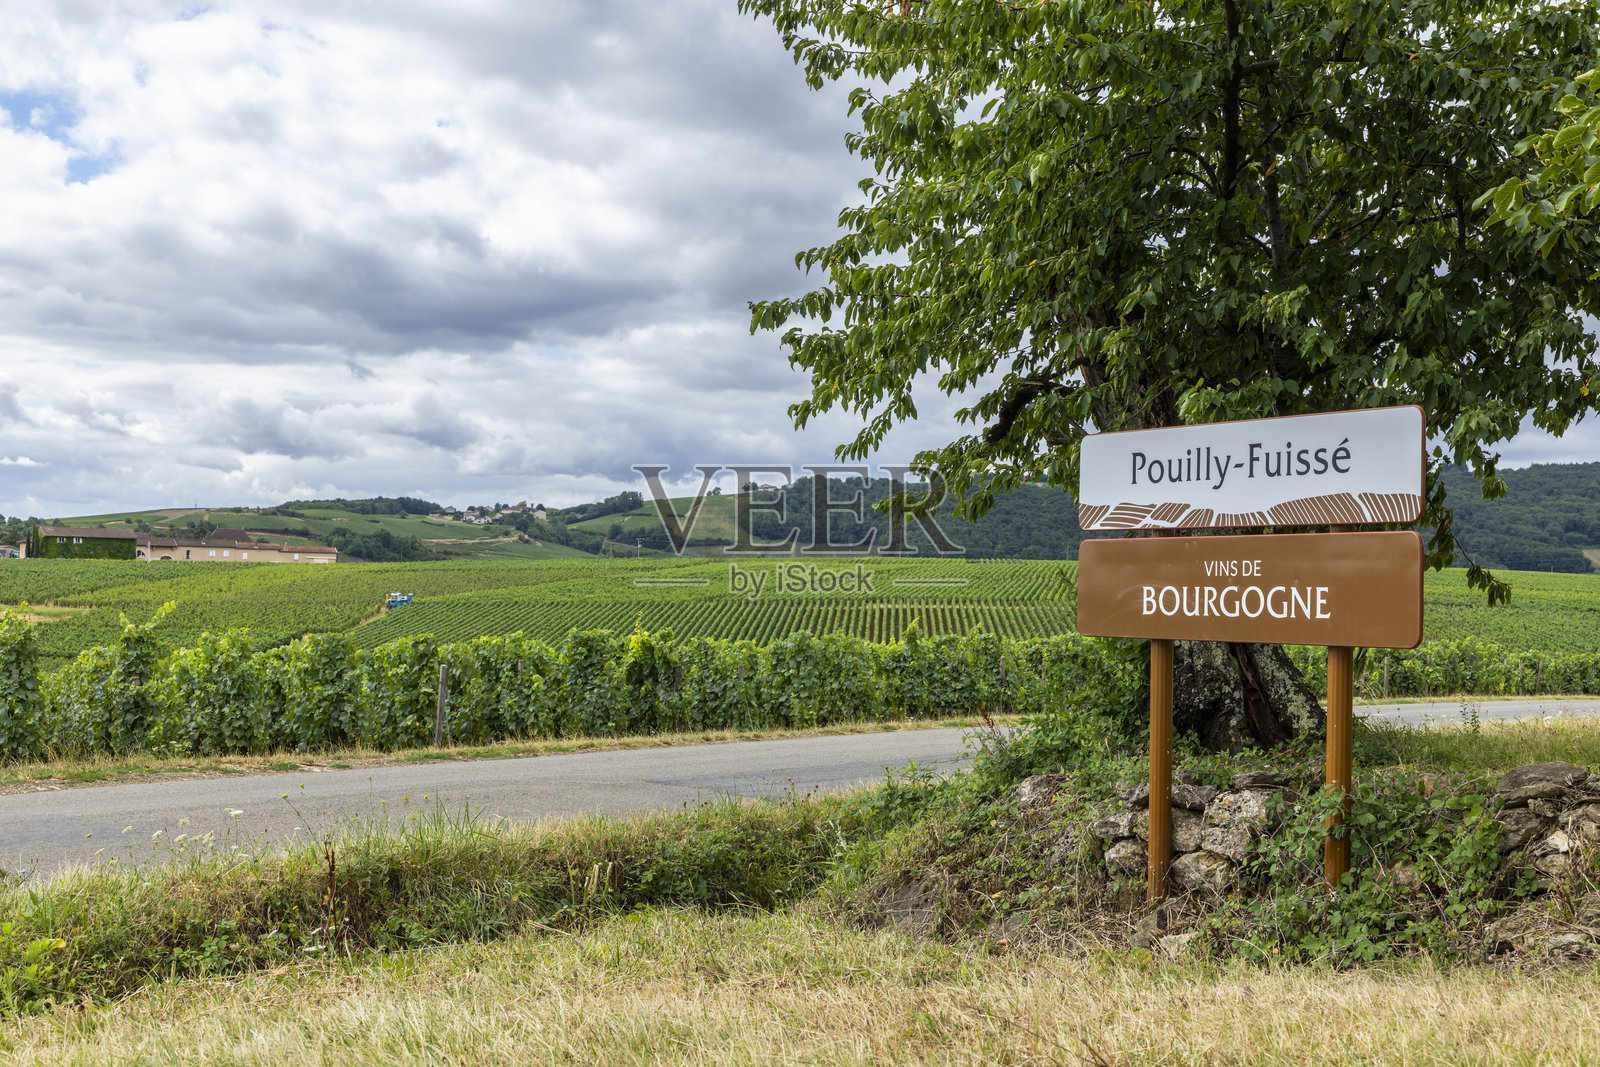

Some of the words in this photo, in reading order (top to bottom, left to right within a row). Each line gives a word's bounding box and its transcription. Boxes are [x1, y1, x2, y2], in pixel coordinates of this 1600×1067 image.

[1131, 437, 1351, 490] Pouilly-Fuissé
[1204, 560, 1238, 577] VINS
[1241, 560, 1262, 577] DE
[1142, 586, 1331, 619] BOURGOGNE
